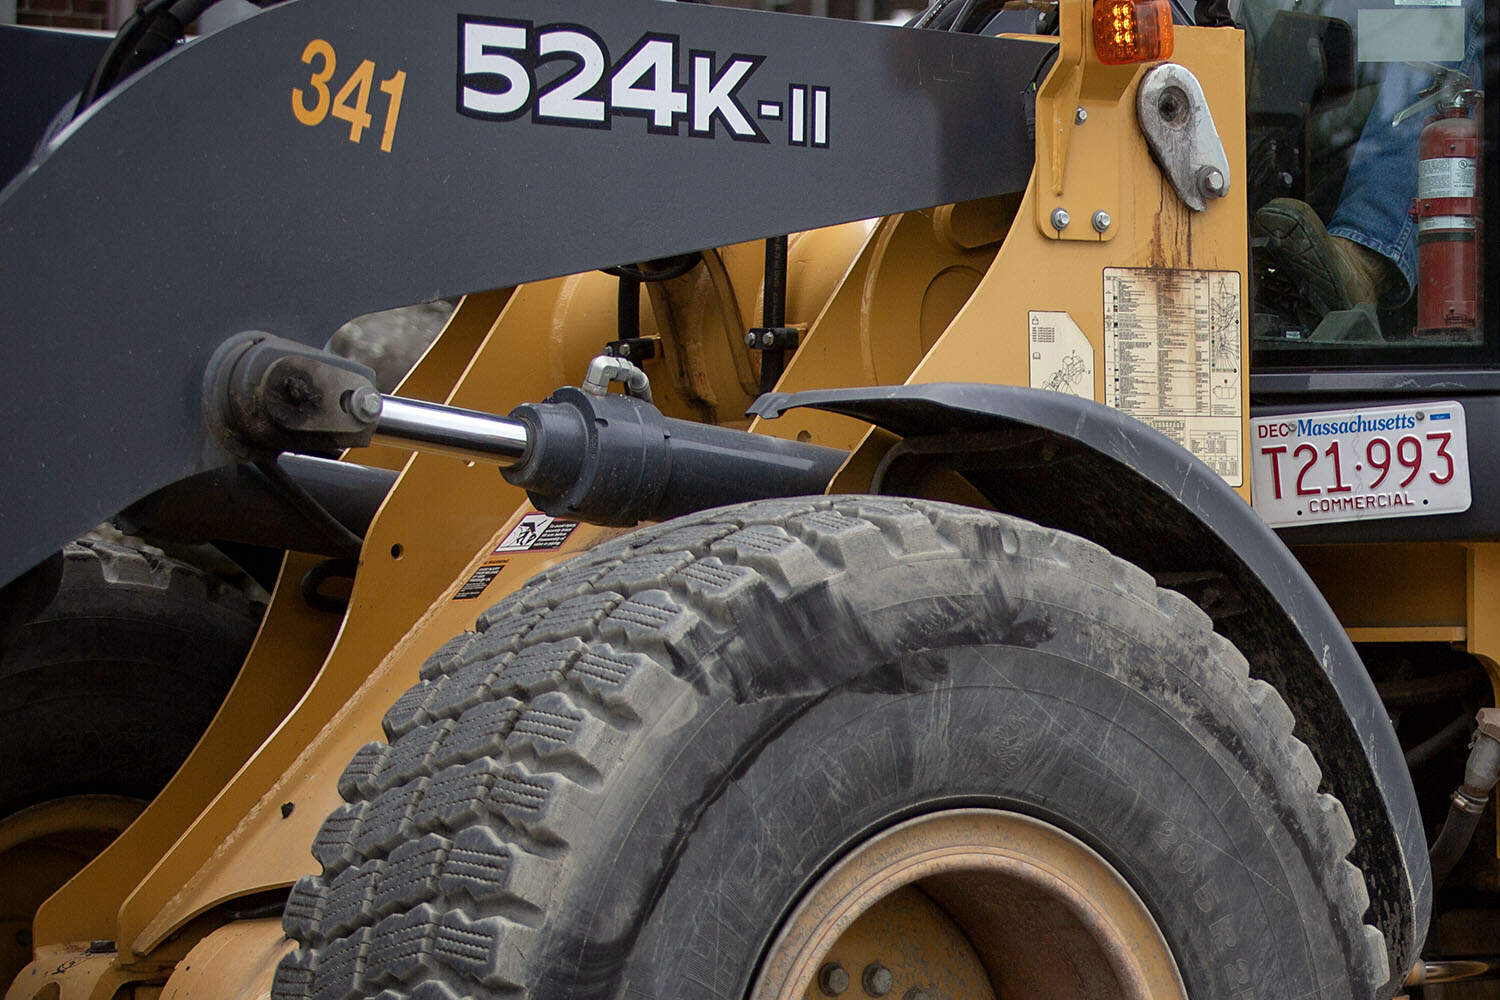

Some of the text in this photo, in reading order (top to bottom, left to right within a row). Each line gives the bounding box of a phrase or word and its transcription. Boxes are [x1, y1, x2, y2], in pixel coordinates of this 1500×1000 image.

[291, 38, 407, 153] 341
[458, 16, 830, 147] 524K-II
[1258, 414, 1416, 438] DEC Massachusetts
[1309, 493, 1415, 513] COMMERCIAL
